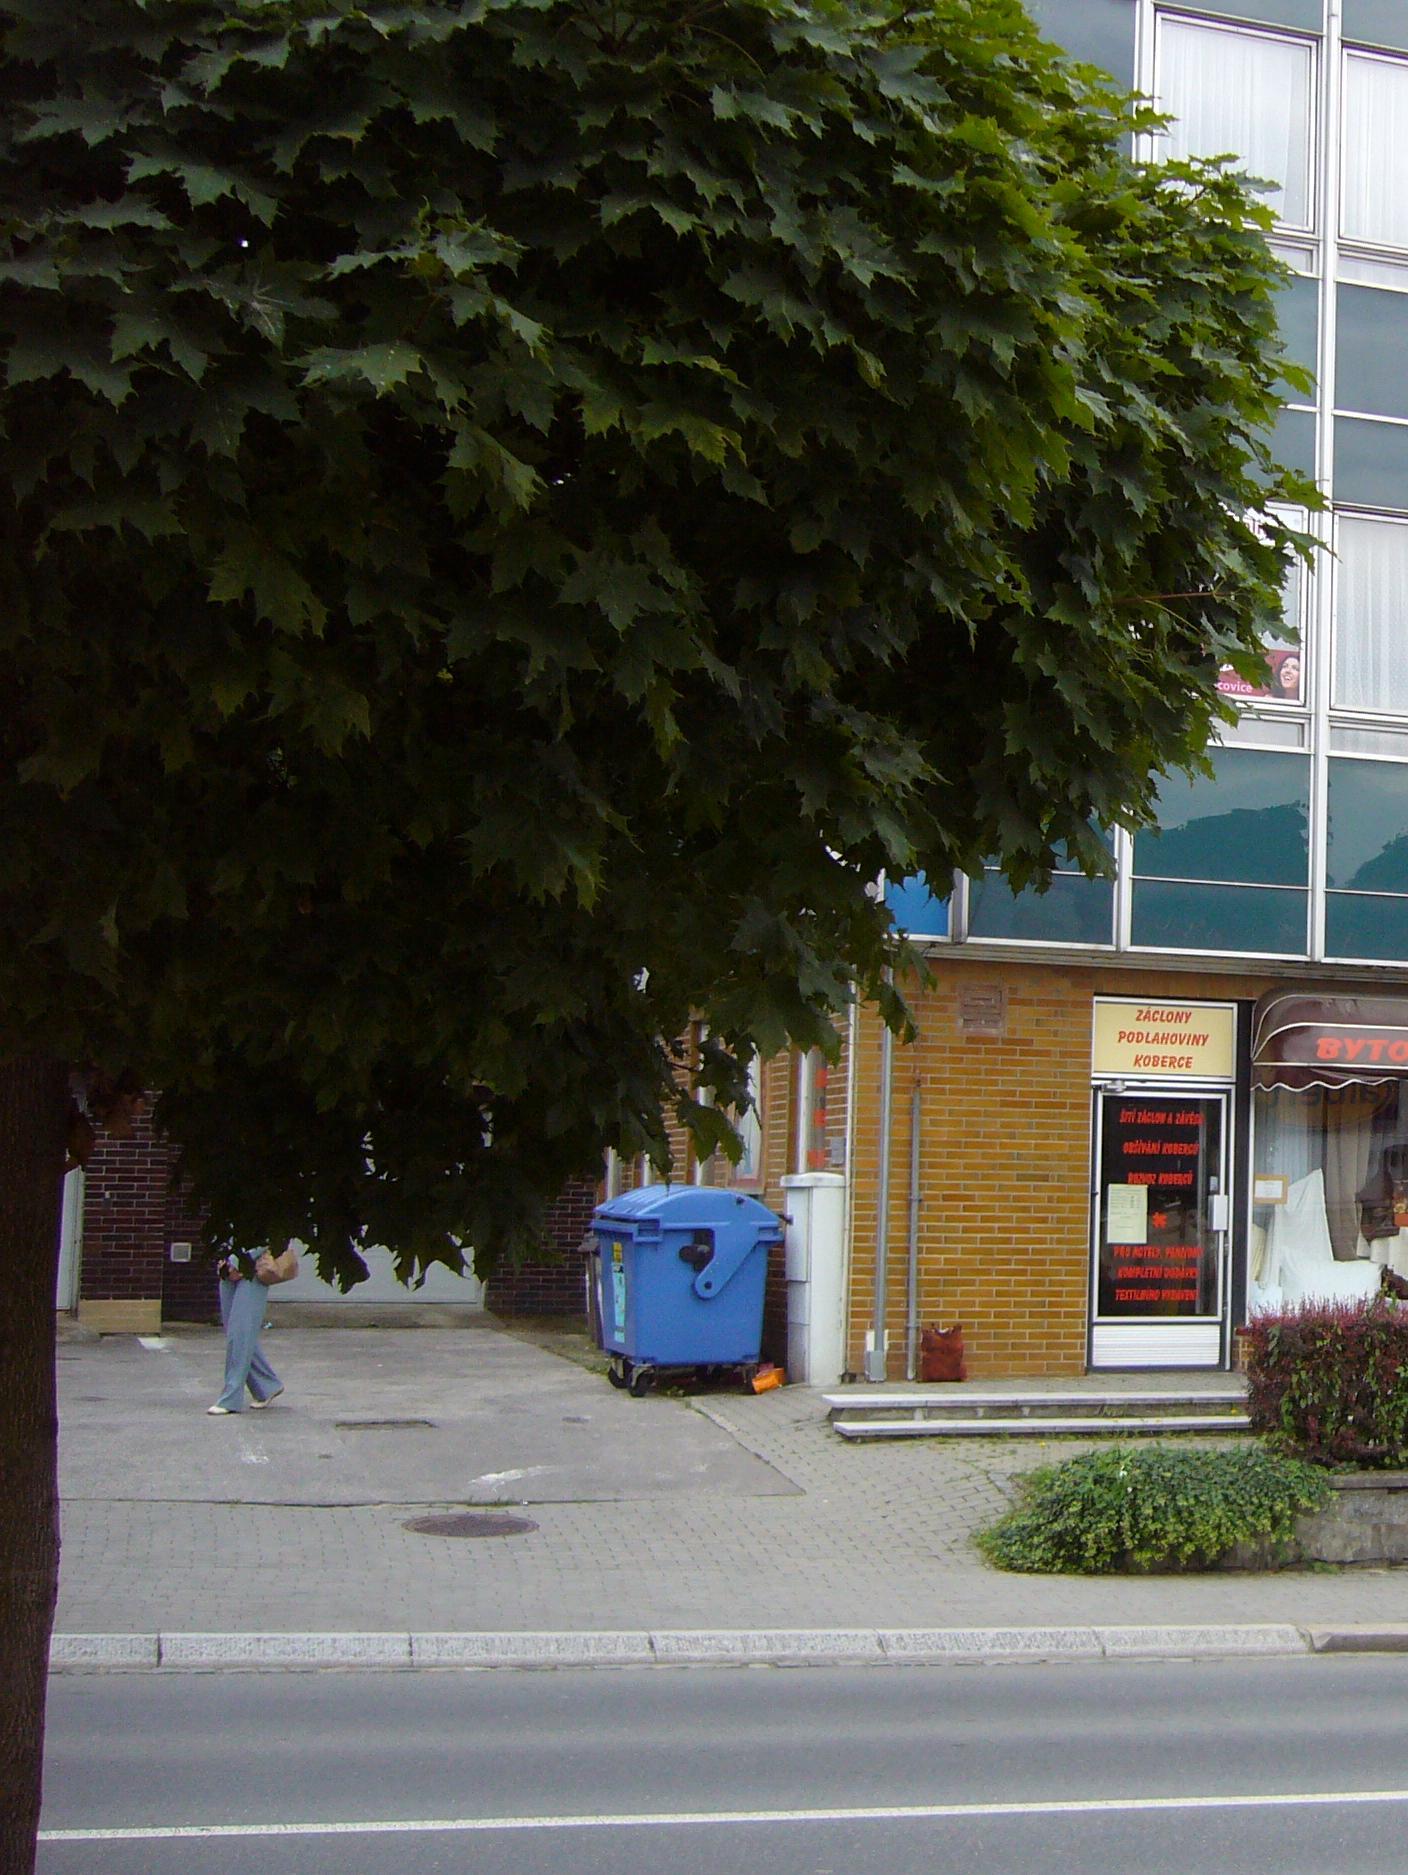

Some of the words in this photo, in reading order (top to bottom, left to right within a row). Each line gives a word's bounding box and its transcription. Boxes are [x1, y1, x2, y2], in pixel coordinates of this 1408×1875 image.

[1136, 1006, 1192, 1024] ZÁCLONY
[1118, 1030, 1209, 1046] PODLAHOVINY
[1133, 1054, 1193, 1068] KOBERCE
